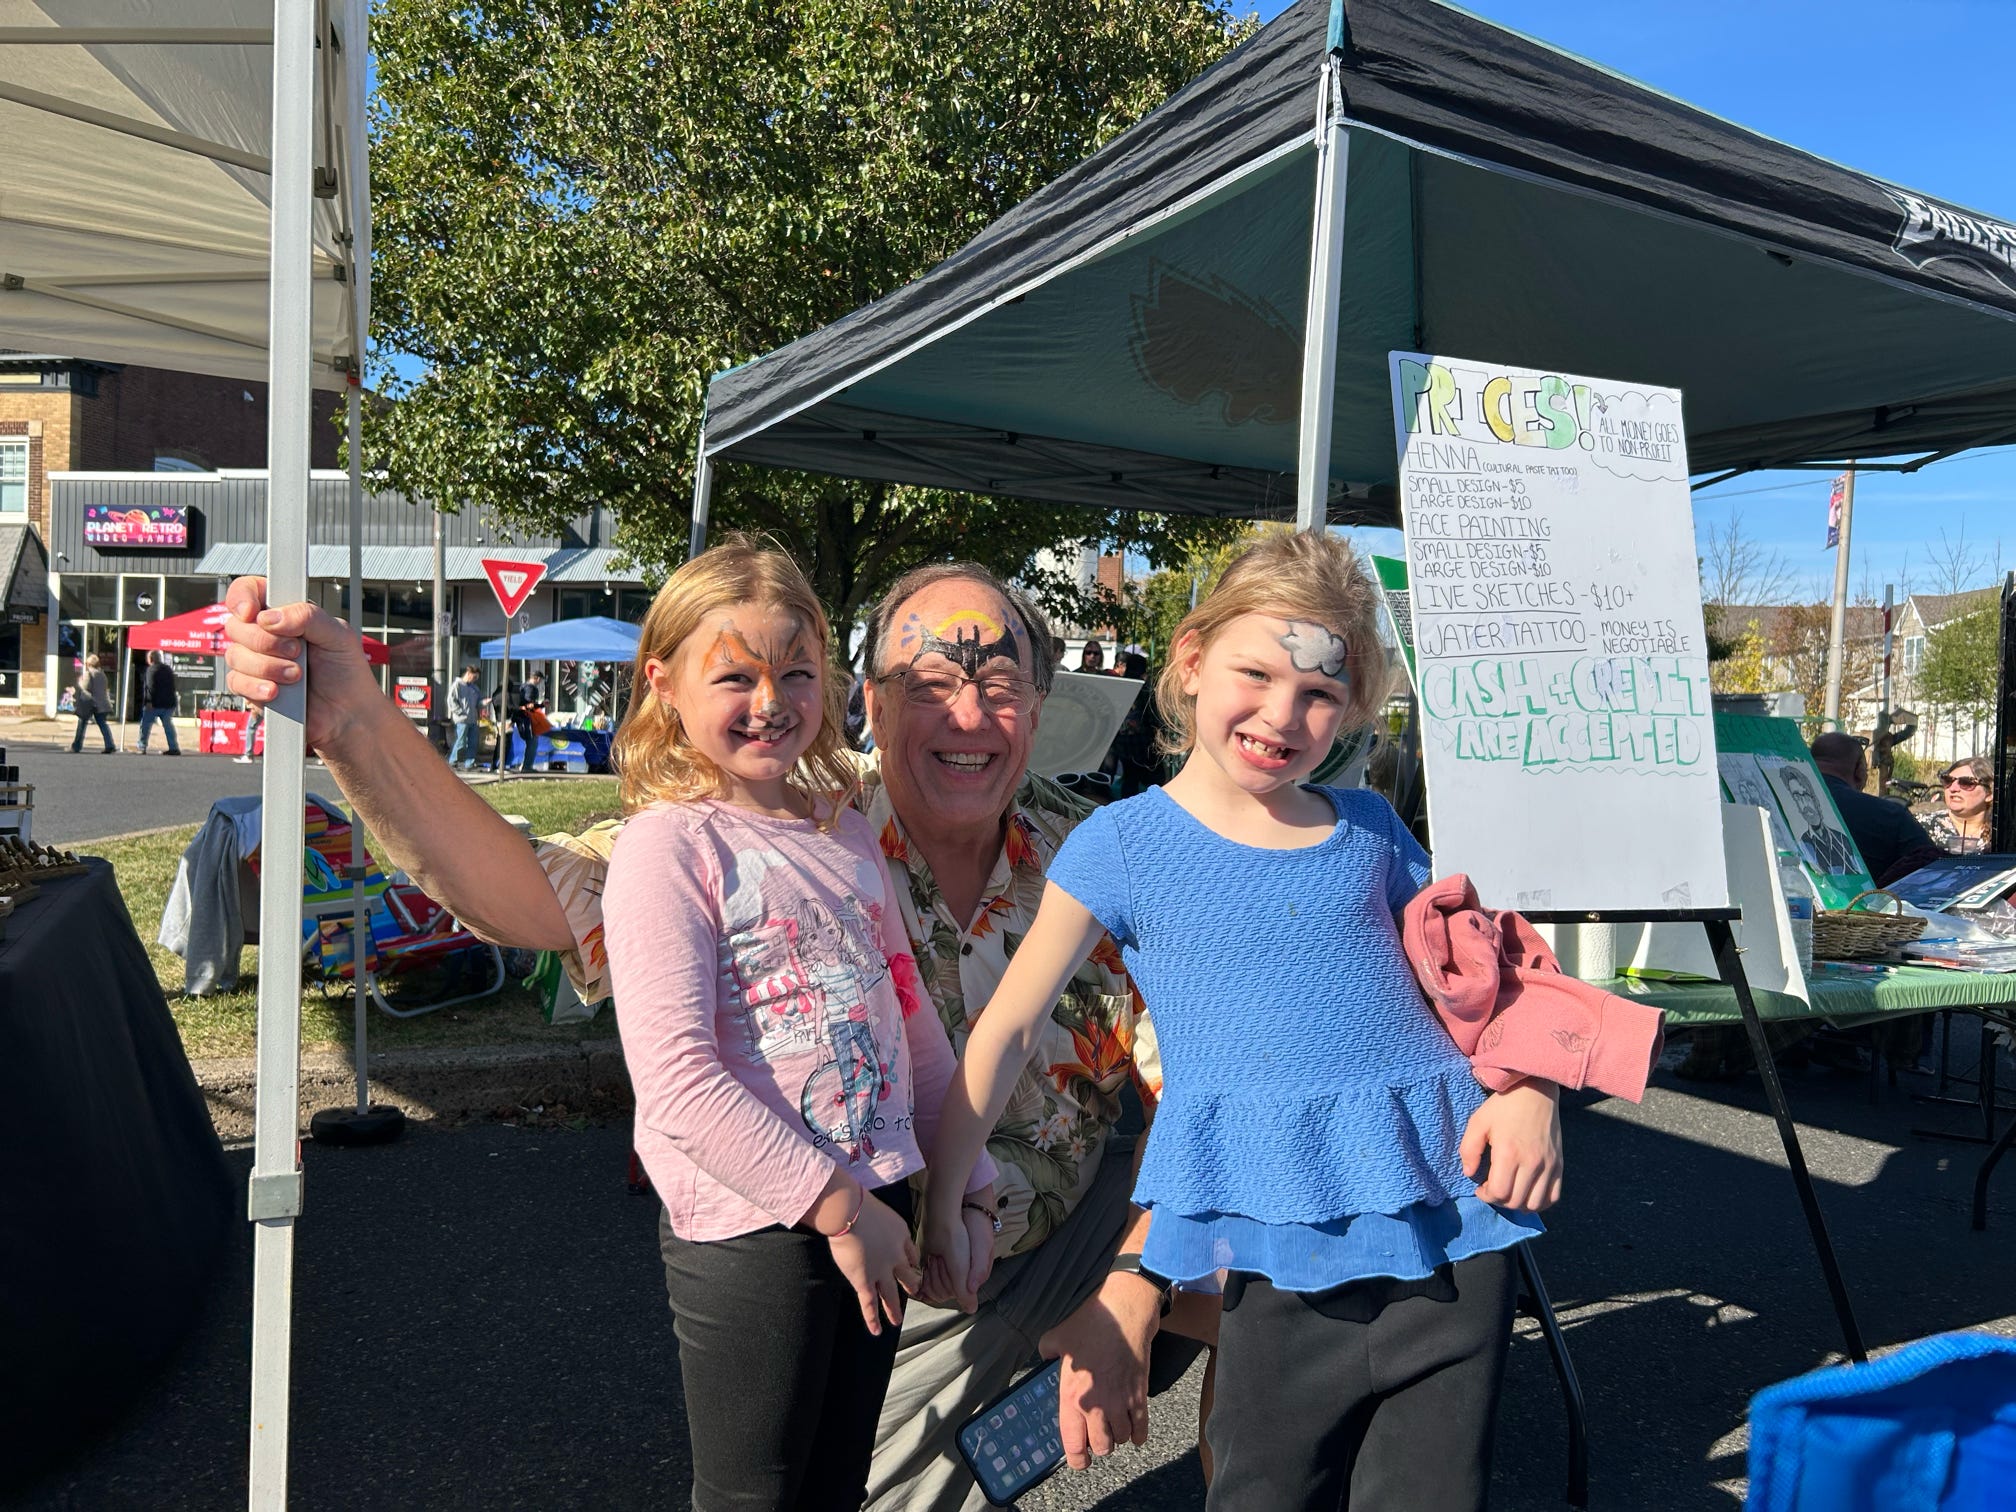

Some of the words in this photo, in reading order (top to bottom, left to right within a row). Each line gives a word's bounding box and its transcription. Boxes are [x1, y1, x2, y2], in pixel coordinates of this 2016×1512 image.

[1399, 359, 1595, 451] PRICES!
[1600, 417, 1618, 435] ALL
[1620, 419, 1653, 441] MONEY
[1654, 422, 1679, 444] GOES
[1407, 441, 1481, 471] HENNA
[1600, 435, 1613, 453] TO
[1618, 438, 1671, 460] NON-PROFIT
[1525, 465, 1545, 475] PASTE
[1408, 475, 1456, 494] SMALL
[1410, 493, 1454, 509] LARGE
[86, 521, 135, 533] PLANET
[142, 523, 183, 533] RETRO
[1410, 512, 1451, 537] FACE
[1458, 514, 1551, 539] PAINTING
[87, 533, 127, 542] VIDEO
[138, 534, 183, 544] GAMES
[1413, 541, 1465, 561] SMALL
[504, 575, 522, 583] YIELD
[1414, 561, 1466, 578] LARGE
[1415, 584, 1467, 610] LIVE
[1473, 581, 1576, 611] SKETCHES
[1419, 622, 1505, 656] WATER
[1511, 619, 1587, 647] TATTOO
[1601, 621, 1650, 638] MONEY
[1654, 620, 1676, 638] IS
[1603, 636, 1691, 654] NEGOTIABLE
[1421, 659, 1548, 720] CASH
[1570, 656, 1708, 717] CREDIT
[1456, 719, 1520, 761] ARE
[1522, 712, 1701, 767] ACCEPTED
[813, 1122, 853, 1149] et's
